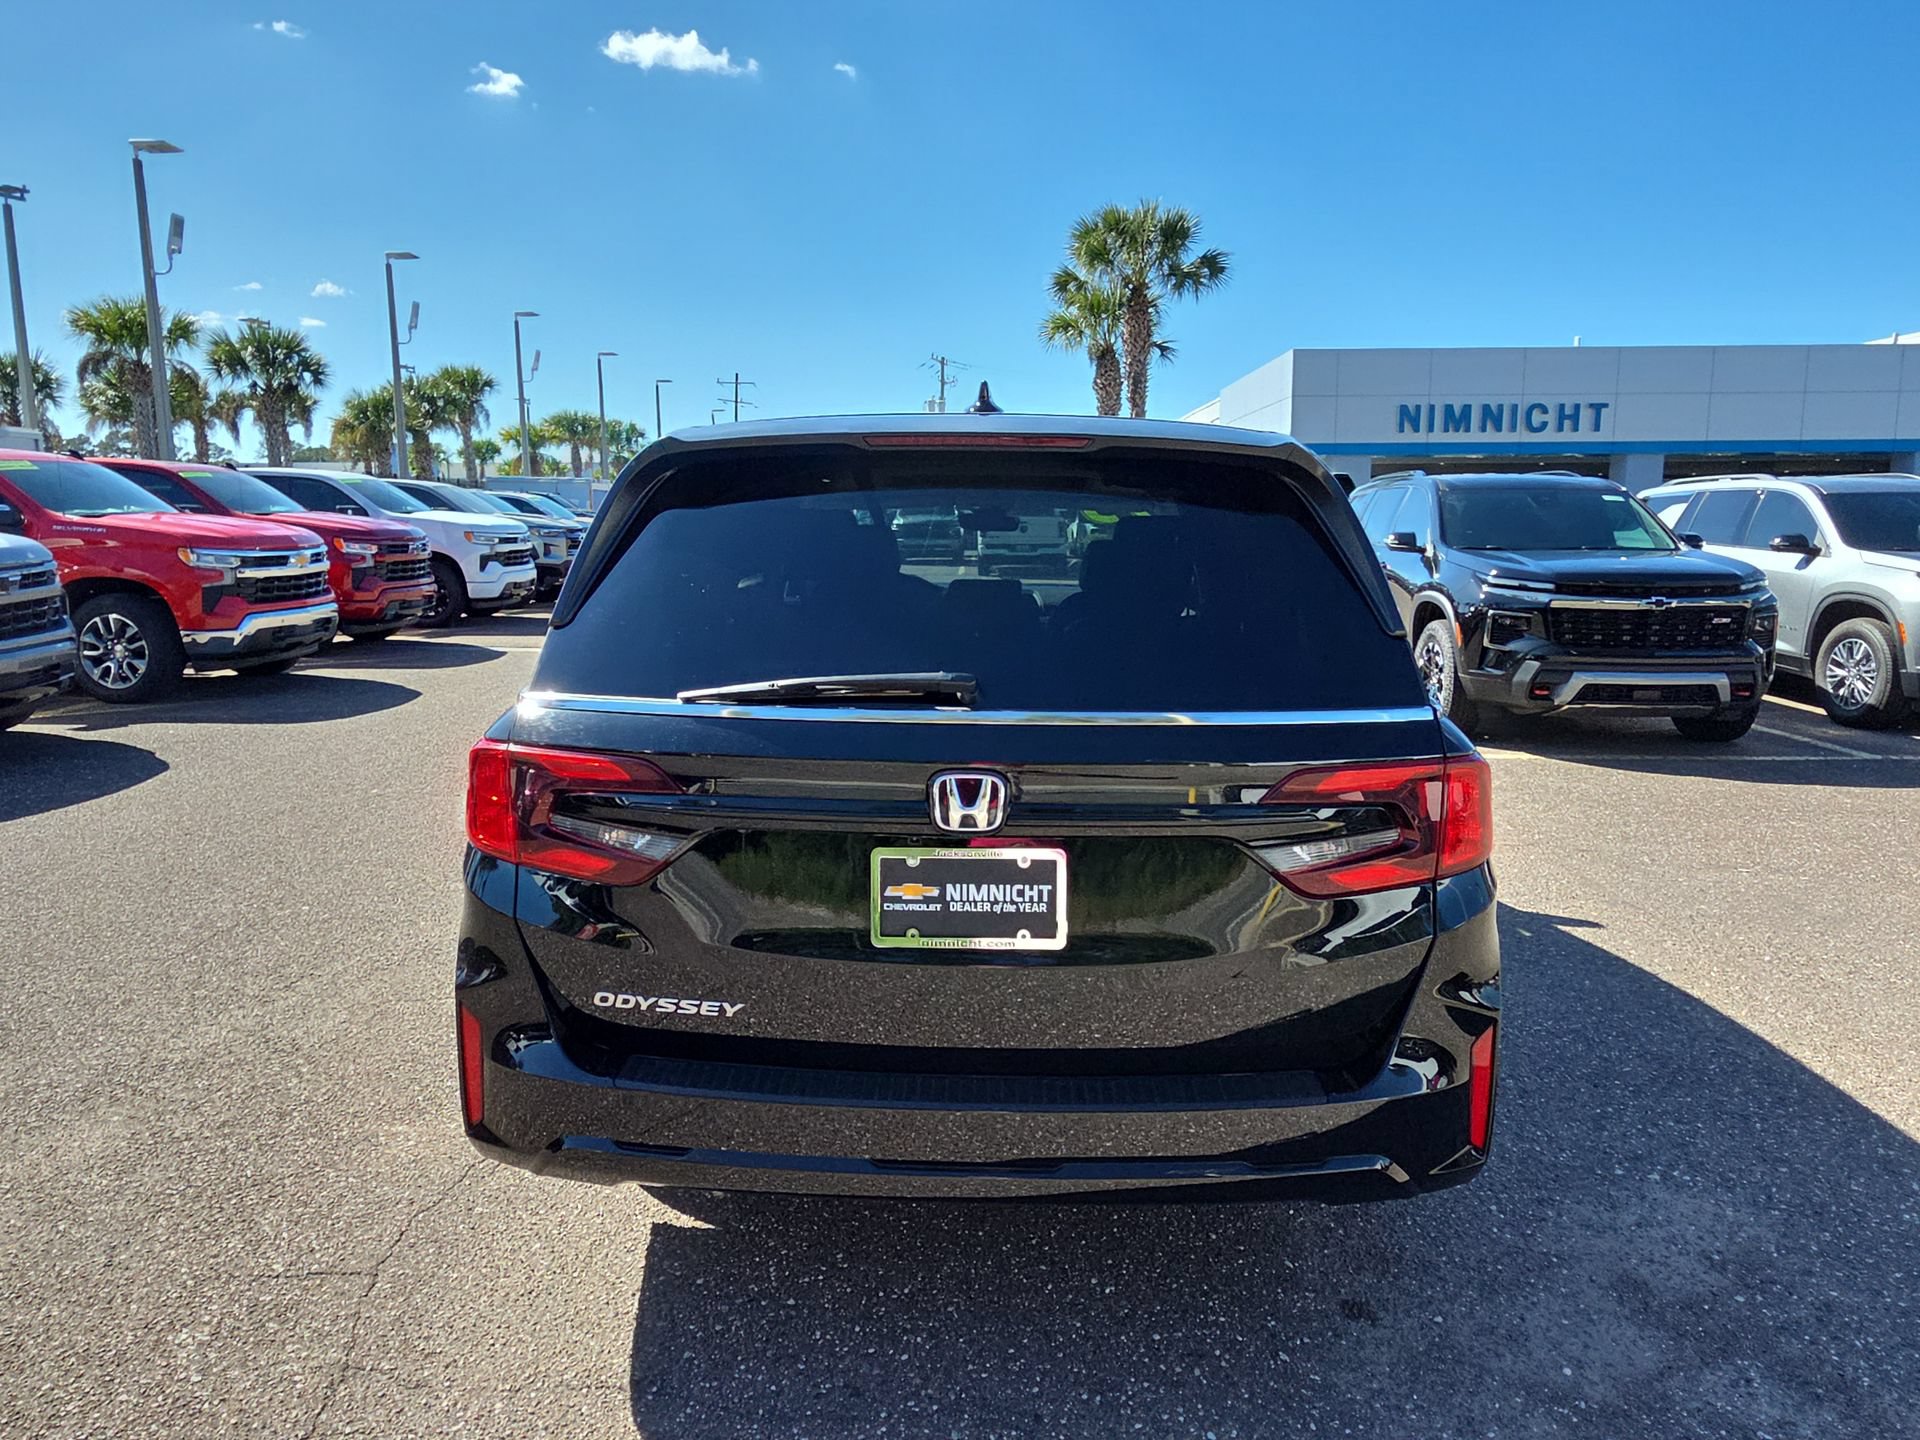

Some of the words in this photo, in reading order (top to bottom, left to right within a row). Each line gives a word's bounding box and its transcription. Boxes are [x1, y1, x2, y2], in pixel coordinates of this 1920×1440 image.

[1398, 403, 1610, 434] NIMNICHT
[945, 883, 1053, 902] NIMNICHT
[883, 903, 943, 912] CHEVROLET
[949, 902, 991, 912] DEALER
[992, 902, 1003, 915] of
[1003, 902, 1017, 912] the
[1017, 902, 1048, 912] YEAR
[919, 938, 1016, 949] nimnicht.com
[593, 991, 746, 1018] ODYSSEY
